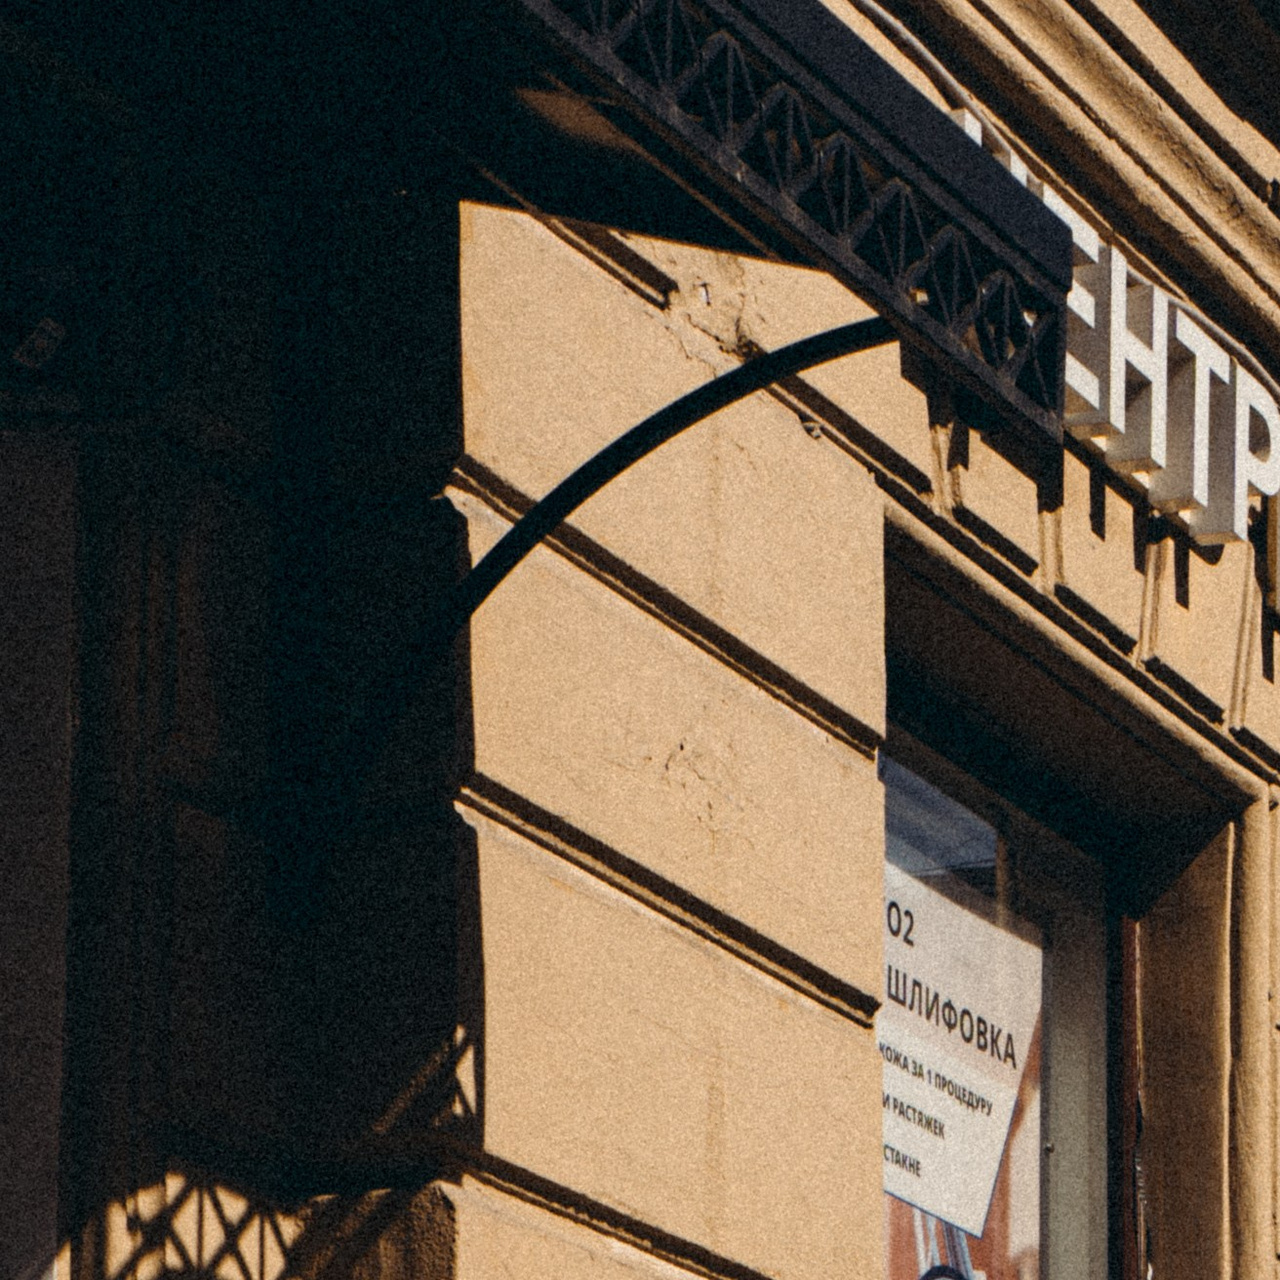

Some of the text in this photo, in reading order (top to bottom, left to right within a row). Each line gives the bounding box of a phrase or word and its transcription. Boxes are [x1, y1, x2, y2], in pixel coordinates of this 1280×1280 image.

[887, 964, 1017, 1069] ШЛИФОВКА
[879, 1042, 993, 1116] КОЖА ЗА 1 ПРОЦЕДУРУ
[892, 1097, 945, 1139] РАСТЯЖЕК
